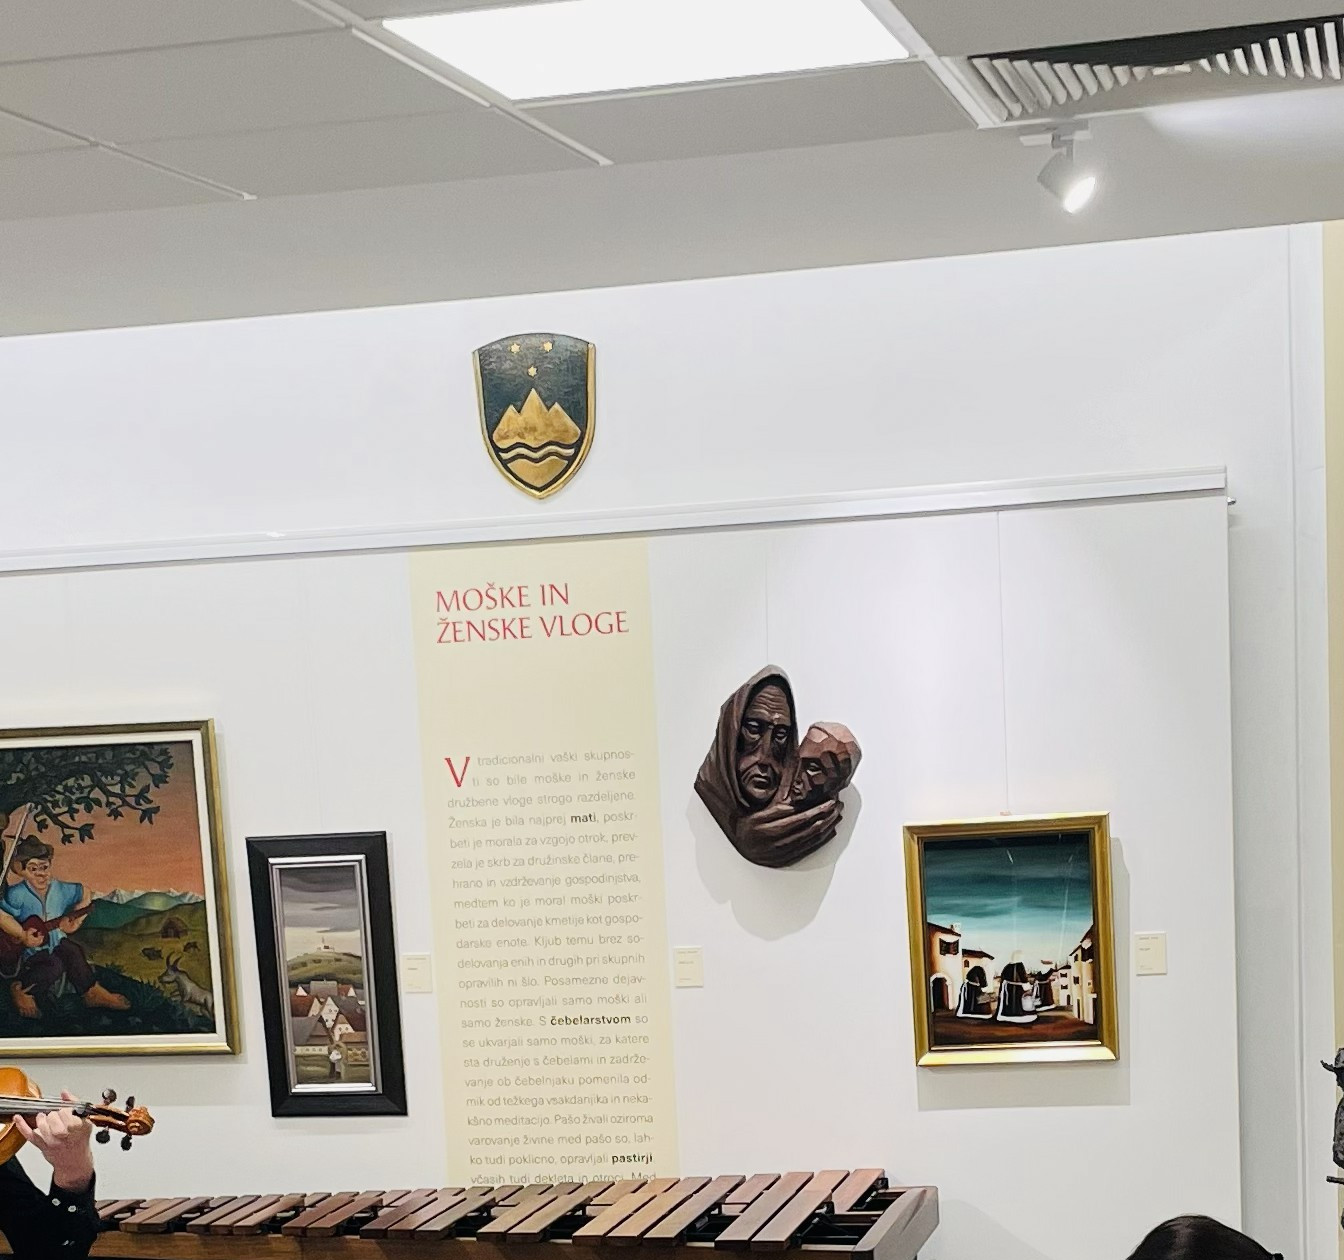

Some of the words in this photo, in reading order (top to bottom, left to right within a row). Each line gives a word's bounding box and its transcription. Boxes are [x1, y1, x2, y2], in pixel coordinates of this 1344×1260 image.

[435, 581, 532, 613] MOŠKE
[538, 582, 570, 606] IN
[435, 616, 533, 645] ŽENSKE
[537, 610, 630, 638] VLOGE
[444, 756, 471, 788] V
[549, 1014, 632, 1027] čebelarstvom
